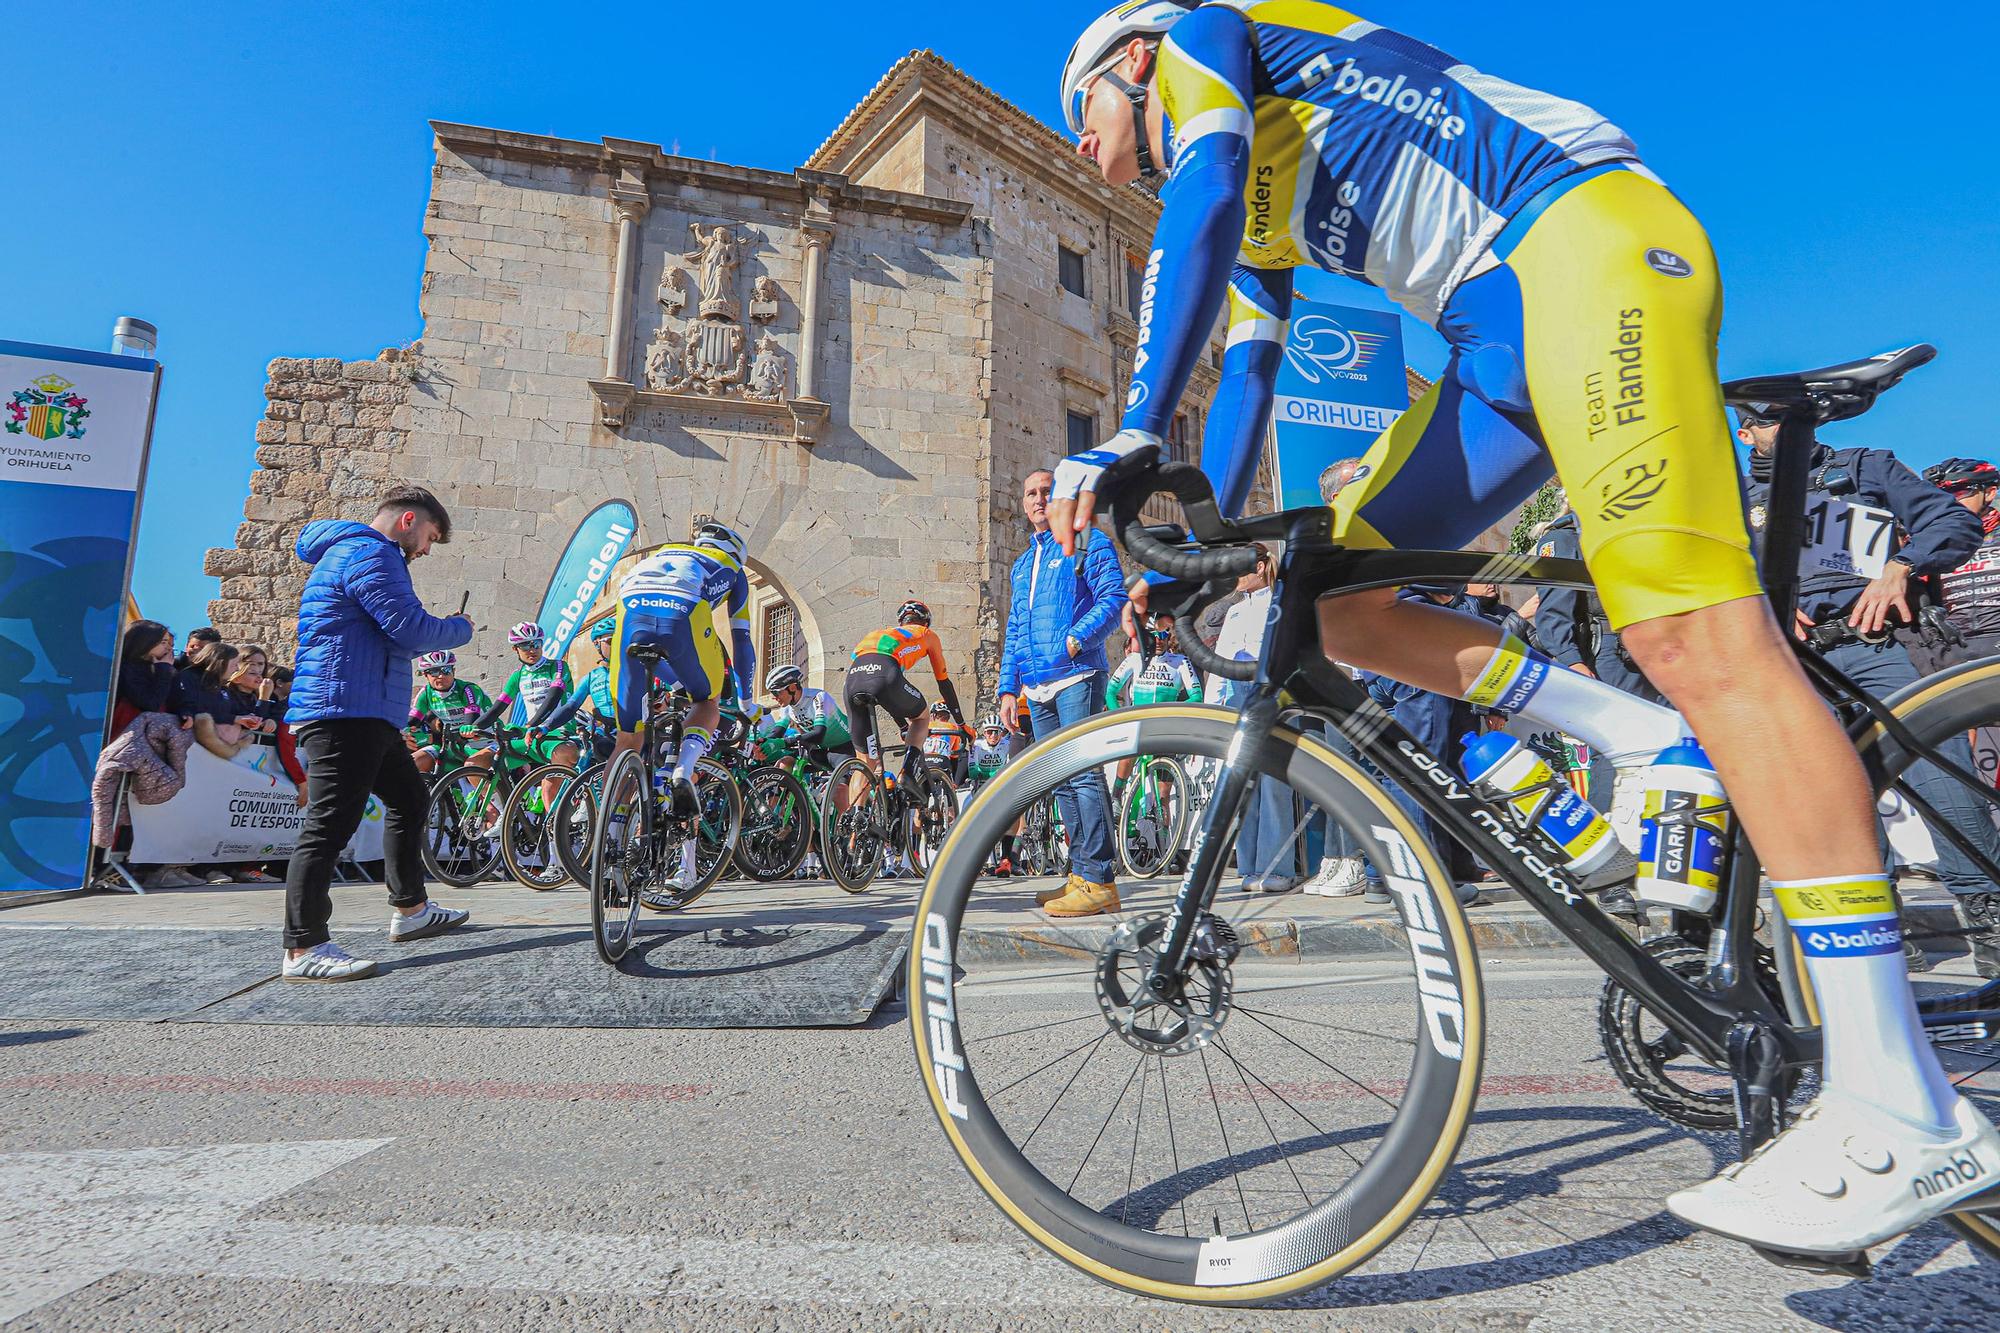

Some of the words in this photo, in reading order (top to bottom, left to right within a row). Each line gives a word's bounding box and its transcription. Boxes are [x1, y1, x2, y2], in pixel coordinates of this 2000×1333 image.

[1332, 58, 1466, 141] baloise
[1250, 164, 1274, 248] landers
[1319, 181, 1361, 266] loise
[1137, 248, 1164, 347] baloise
[1610, 307, 1646, 426] Flanders
[1584, 371, 1608, 441] Team
[7, 458, 73, 471] ORIHUELA
[1809, 500, 1892, 557] 117
[542, 523, 631, 660] Sabadell
[641, 597, 688, 614] baloise
[1503, 663, 1545, 709] baloise
[230, 814, 247, 827] DE
[232, 788, 272, 799] Comunitat
[272, 791, 300, 801] Valencia
[1396, 740, 1471, 800] eddy
[1470, 809, 1583, 906] merckx
[1159, 903, 1183, 954] eddy
[1912, 1148, 1987, 1200] nimbl
[1209, 1258, 1232, 1267] RYOT
